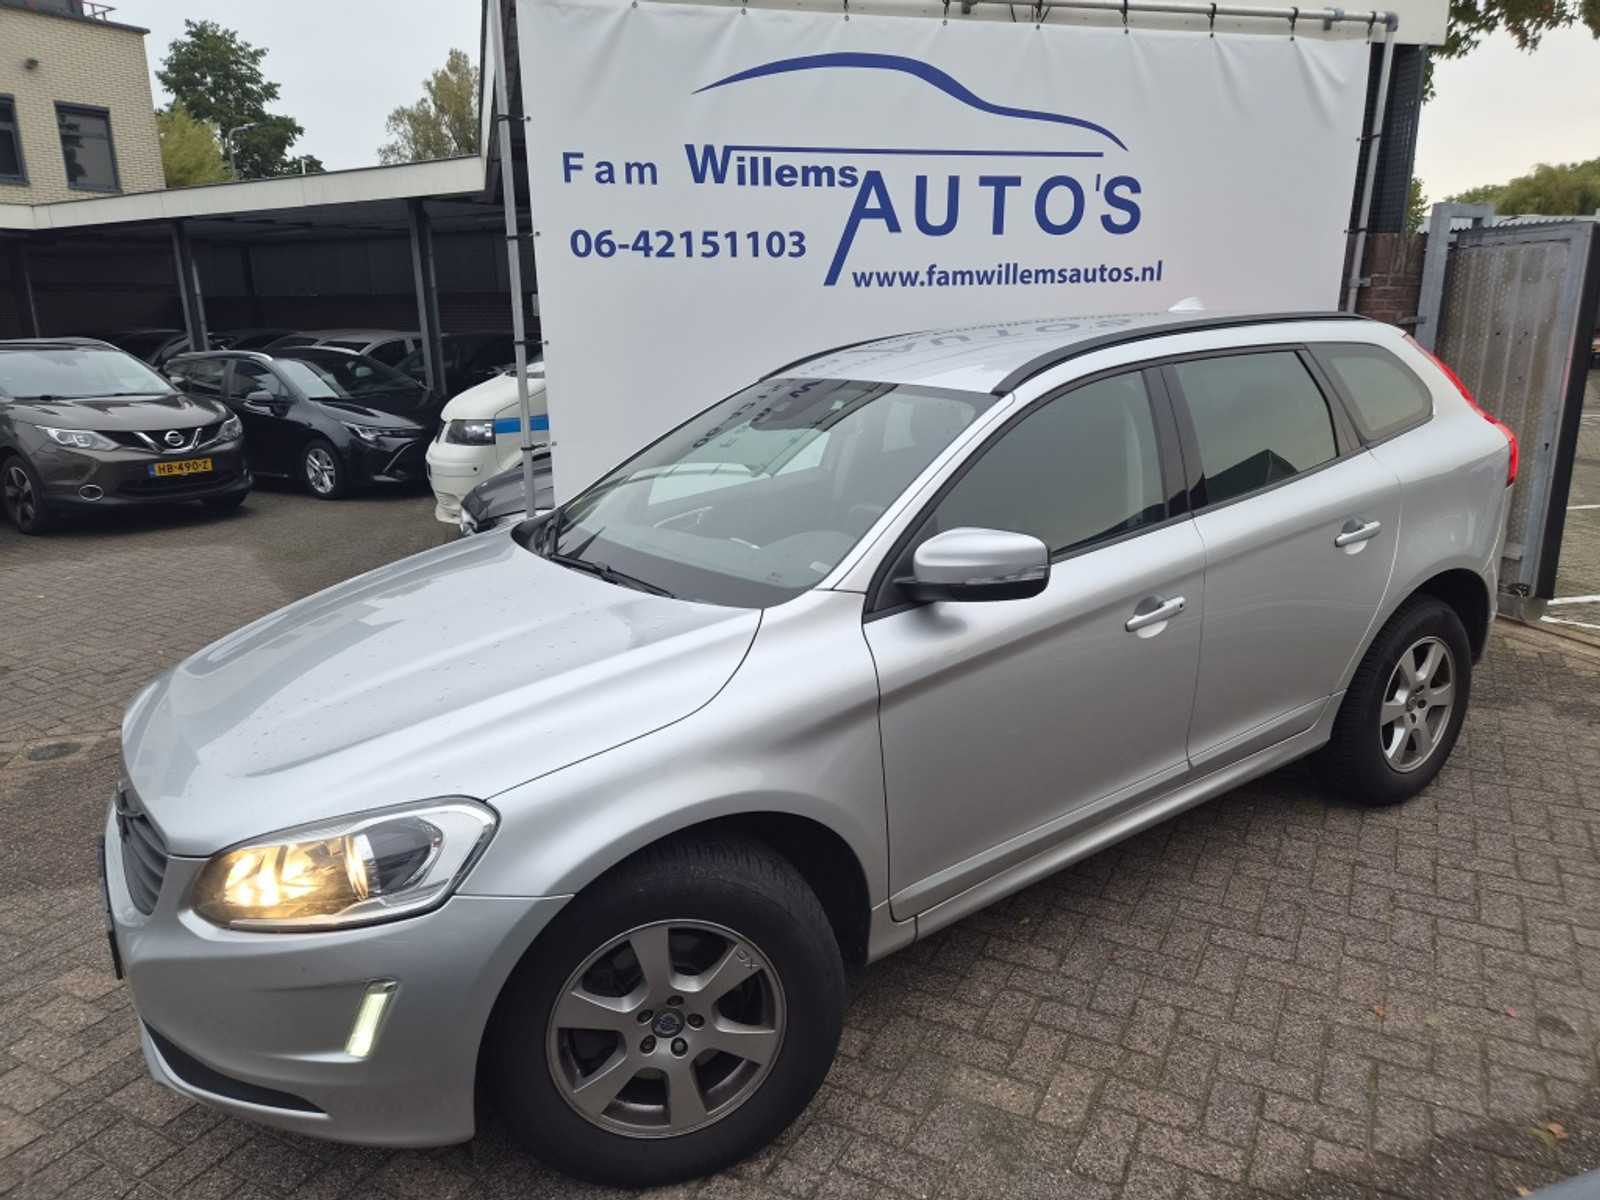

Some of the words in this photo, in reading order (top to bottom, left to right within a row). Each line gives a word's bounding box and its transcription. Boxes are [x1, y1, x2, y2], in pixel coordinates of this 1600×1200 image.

[561, 152, 658, 185] Fam
[684, 143, 860, 188] Willems
[823, 170, 1142, 287] AUTO'S
[569, 229, 807, 259] 06-42151103
[852, 260, 1163, 289] www.famwillemsautos.nl
[157, 459, 209, 475] HB-490-Z
